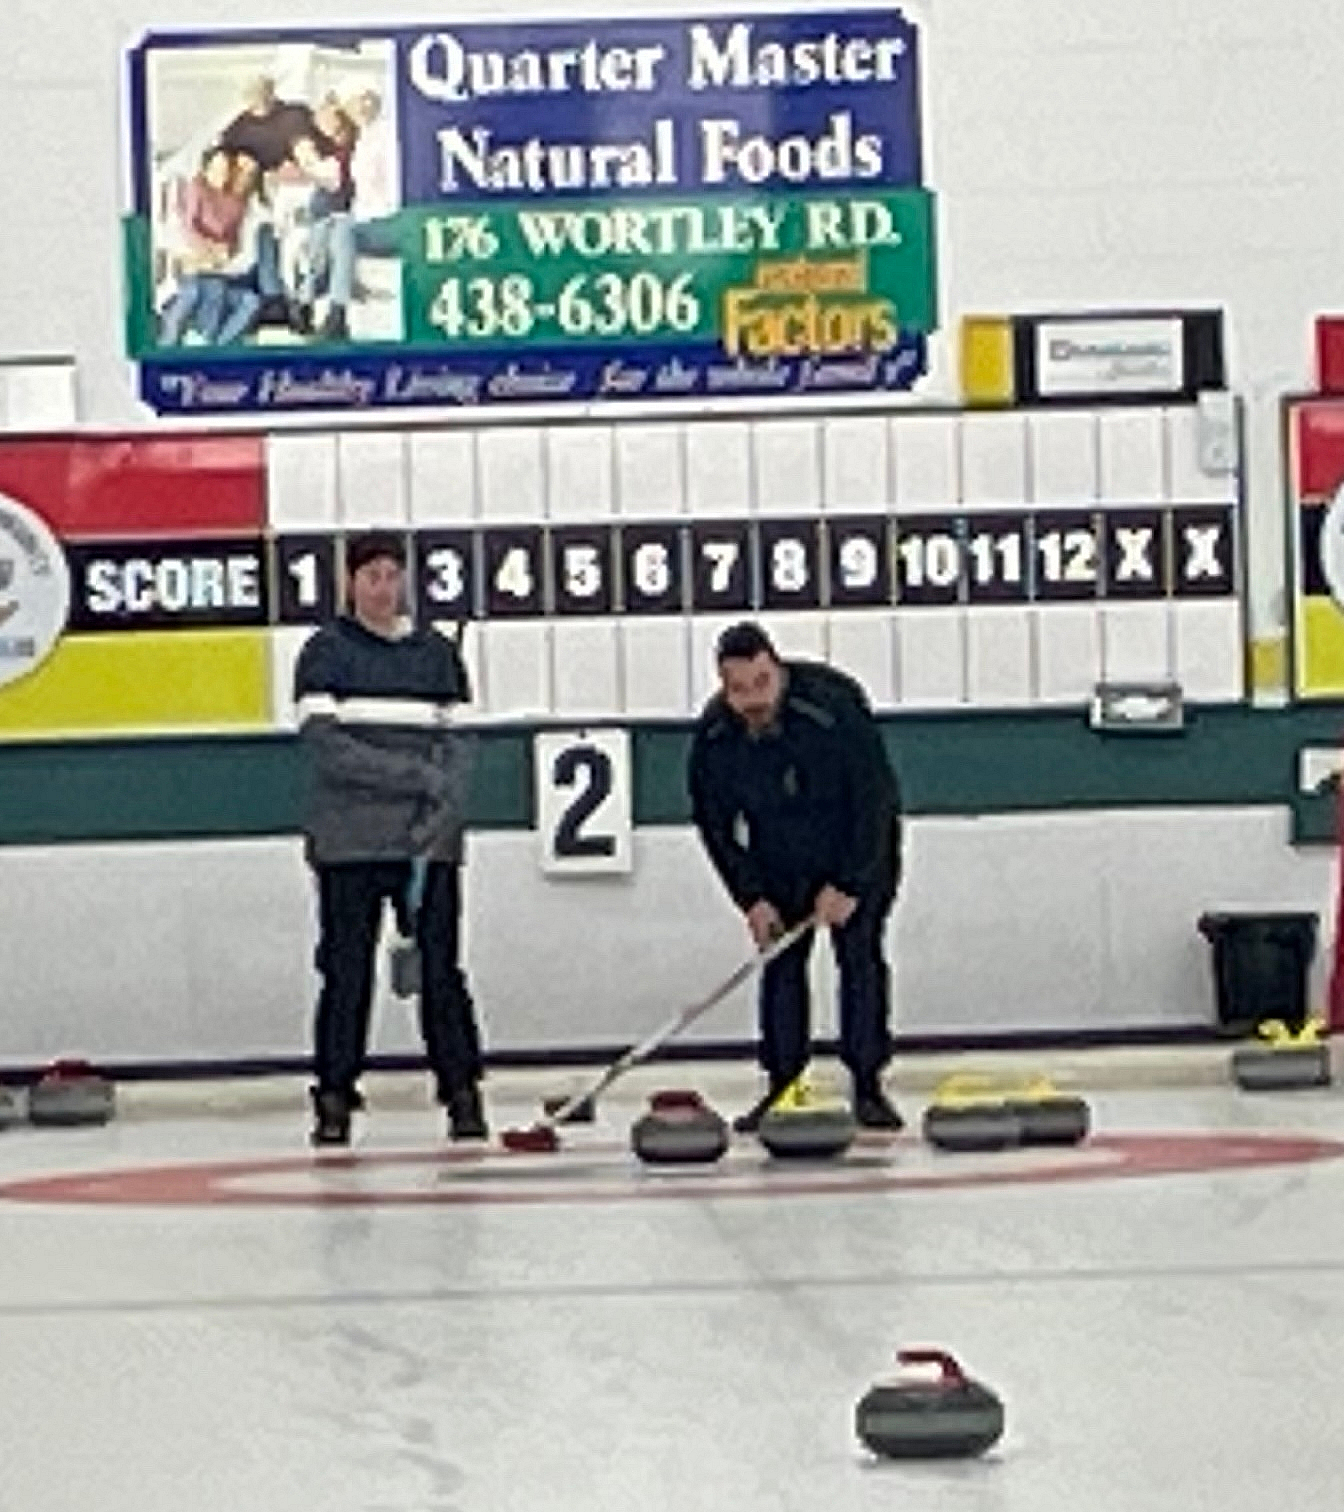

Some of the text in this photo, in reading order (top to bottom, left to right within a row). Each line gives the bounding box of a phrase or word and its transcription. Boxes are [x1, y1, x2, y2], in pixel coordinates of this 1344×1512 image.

[409, 23, 904, 101] Quarter Master
[436, 110, 882, 192] Natural Foods
[424, 198, 902, 260] 176 WORTLEY RD.
[430, 274, 699, 338] 438-6306
[726, 290, 898, 357] Factors
[87, 526, 1222, 612] SCORE 1 3 4 5 6 7 8 9 10 11 12 X X
[553, 746, 616, 858] 2
